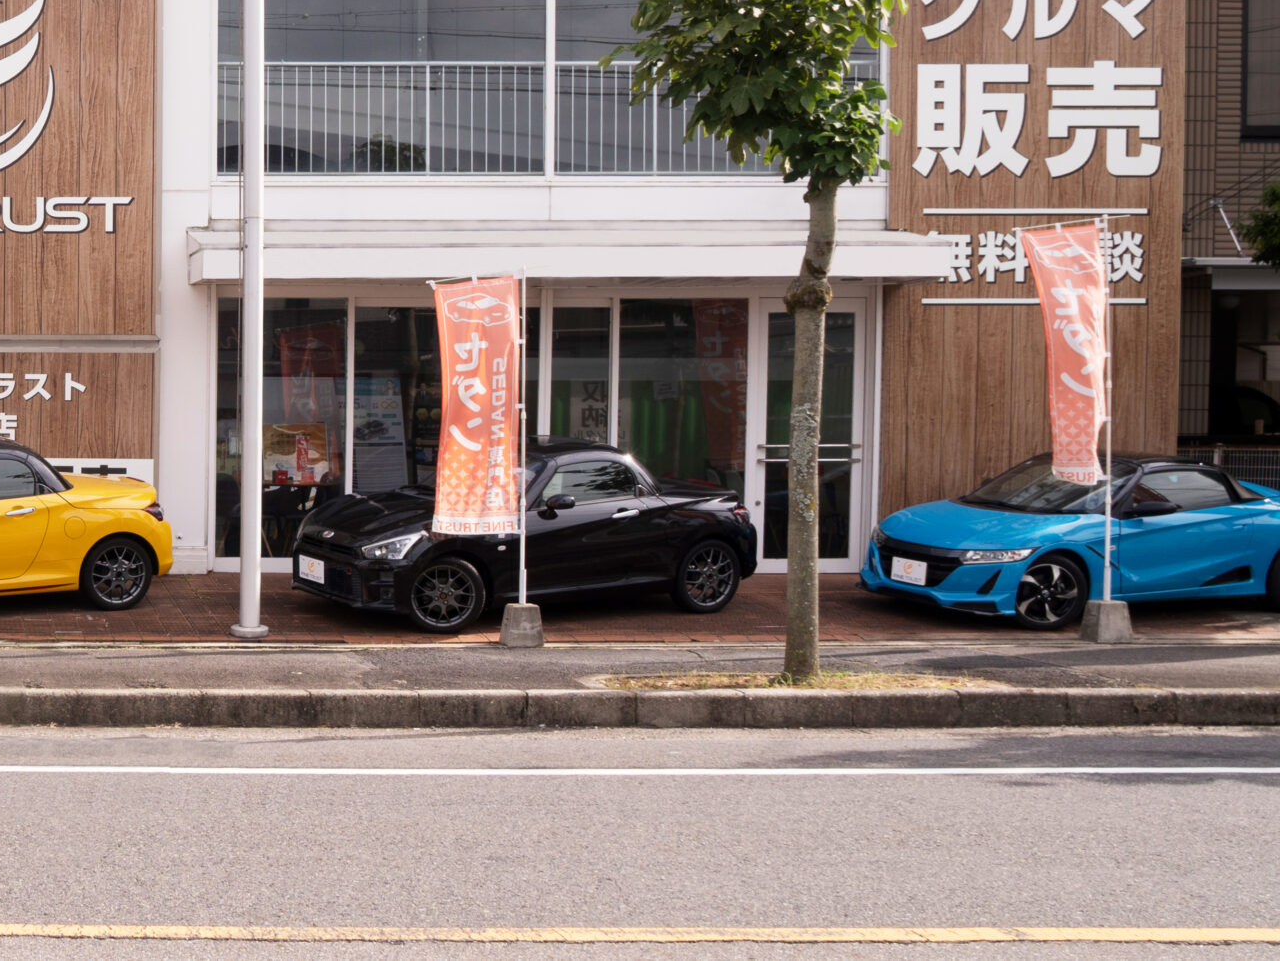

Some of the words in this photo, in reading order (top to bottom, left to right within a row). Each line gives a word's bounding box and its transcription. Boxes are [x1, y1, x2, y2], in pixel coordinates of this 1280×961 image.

[913, 60, 1163, 177] 販売
[926, 230, 1145, 283] 無料談
